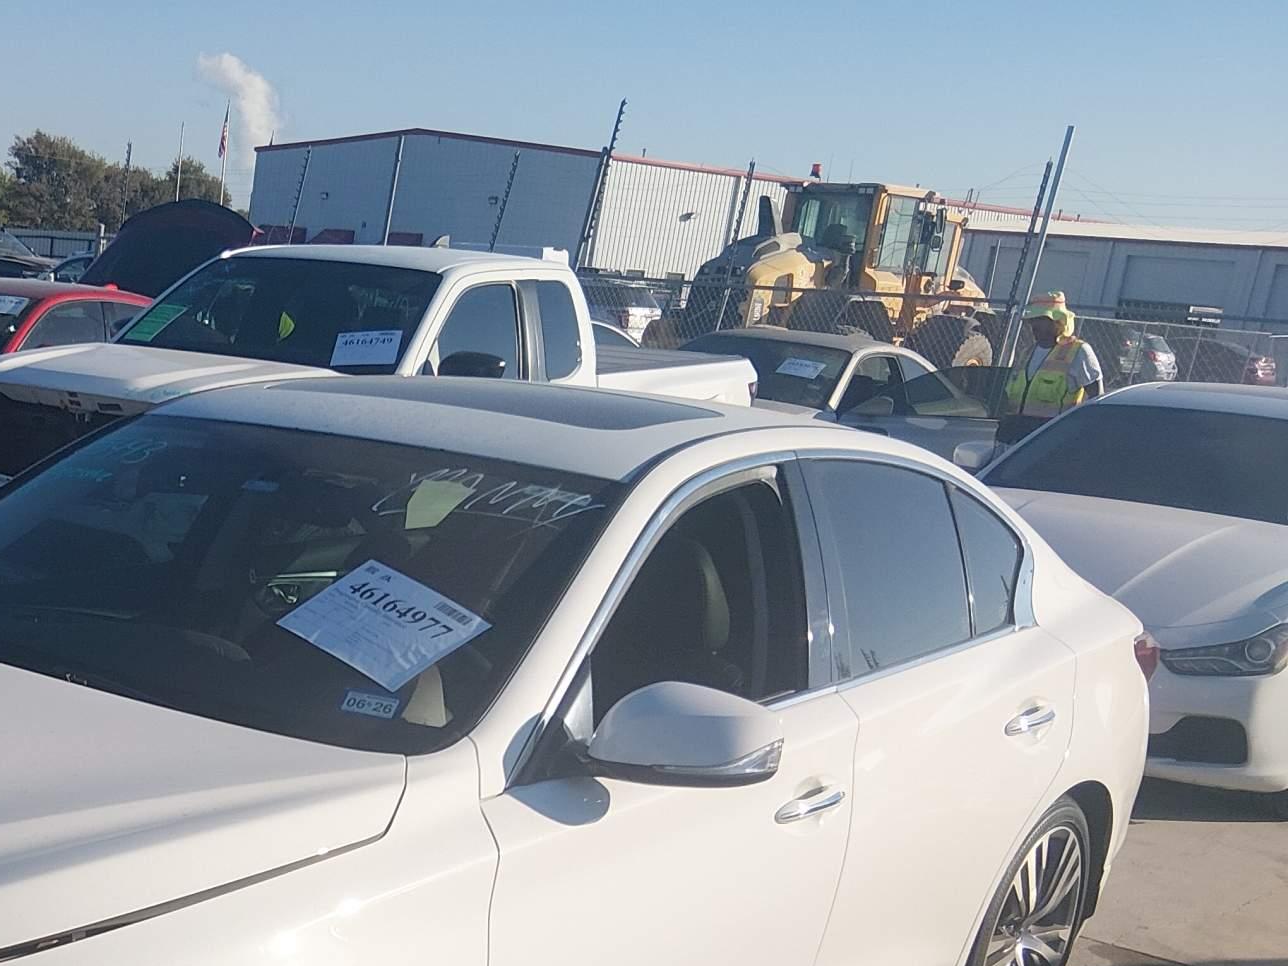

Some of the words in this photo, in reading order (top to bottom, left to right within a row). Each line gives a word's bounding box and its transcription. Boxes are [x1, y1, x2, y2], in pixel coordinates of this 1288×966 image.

[349, 582, 454, 640] 46164977
[346, 699, 365, 710] 06
[372, 701, 393, 715] 26
